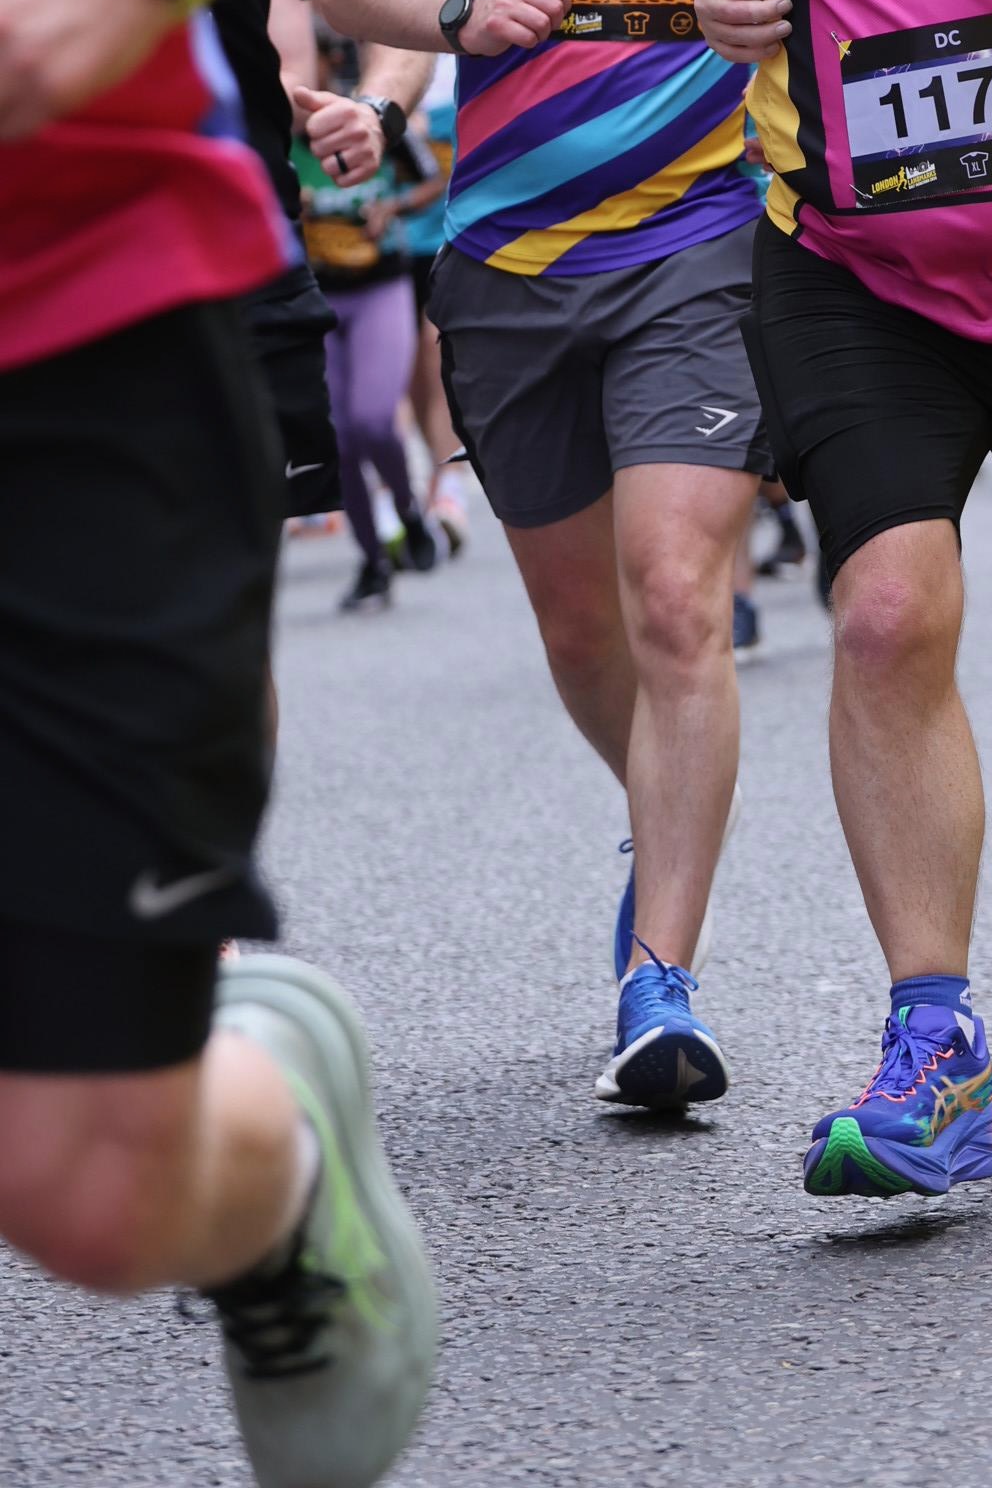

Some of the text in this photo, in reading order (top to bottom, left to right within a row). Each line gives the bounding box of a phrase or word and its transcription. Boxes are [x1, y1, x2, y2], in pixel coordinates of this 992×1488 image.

[933, 29, 962, 49] DC
[970, 160, 982, 173] XL
[871, 173, 899, 194] LONDON
